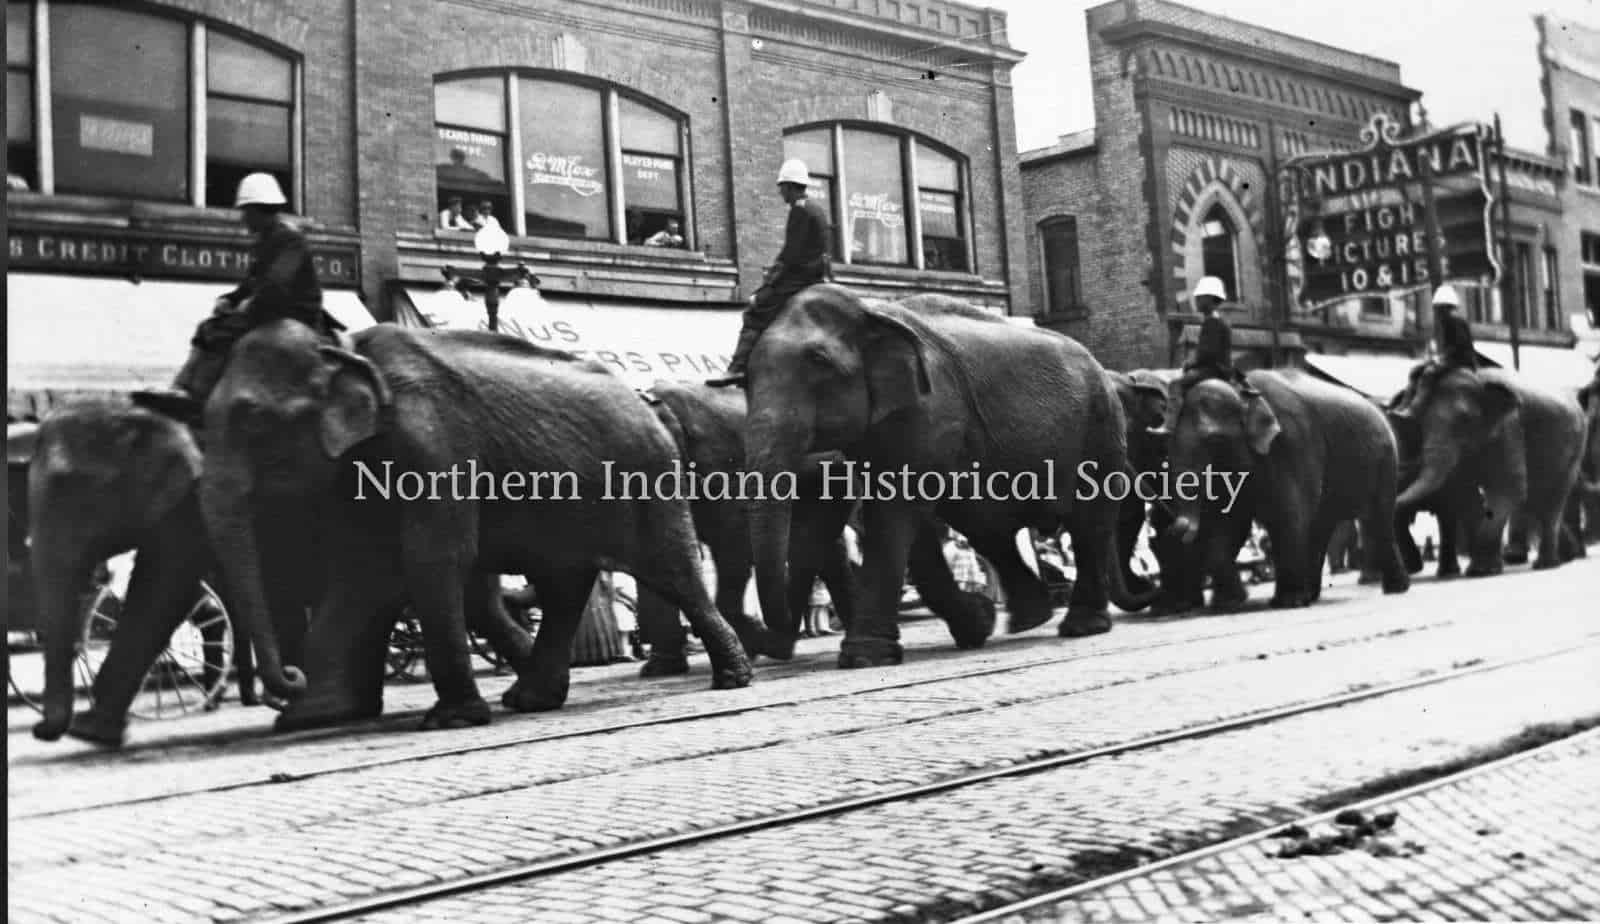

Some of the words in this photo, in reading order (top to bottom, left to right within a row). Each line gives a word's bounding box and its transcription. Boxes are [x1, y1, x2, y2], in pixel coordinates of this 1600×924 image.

[1344, 201, 1415, 234] FIGH
[37, 238, 147, 262] CREDIT
[1334, 231, 1446, 264] ICTURE
[1376, 263, 1393, 288] &
